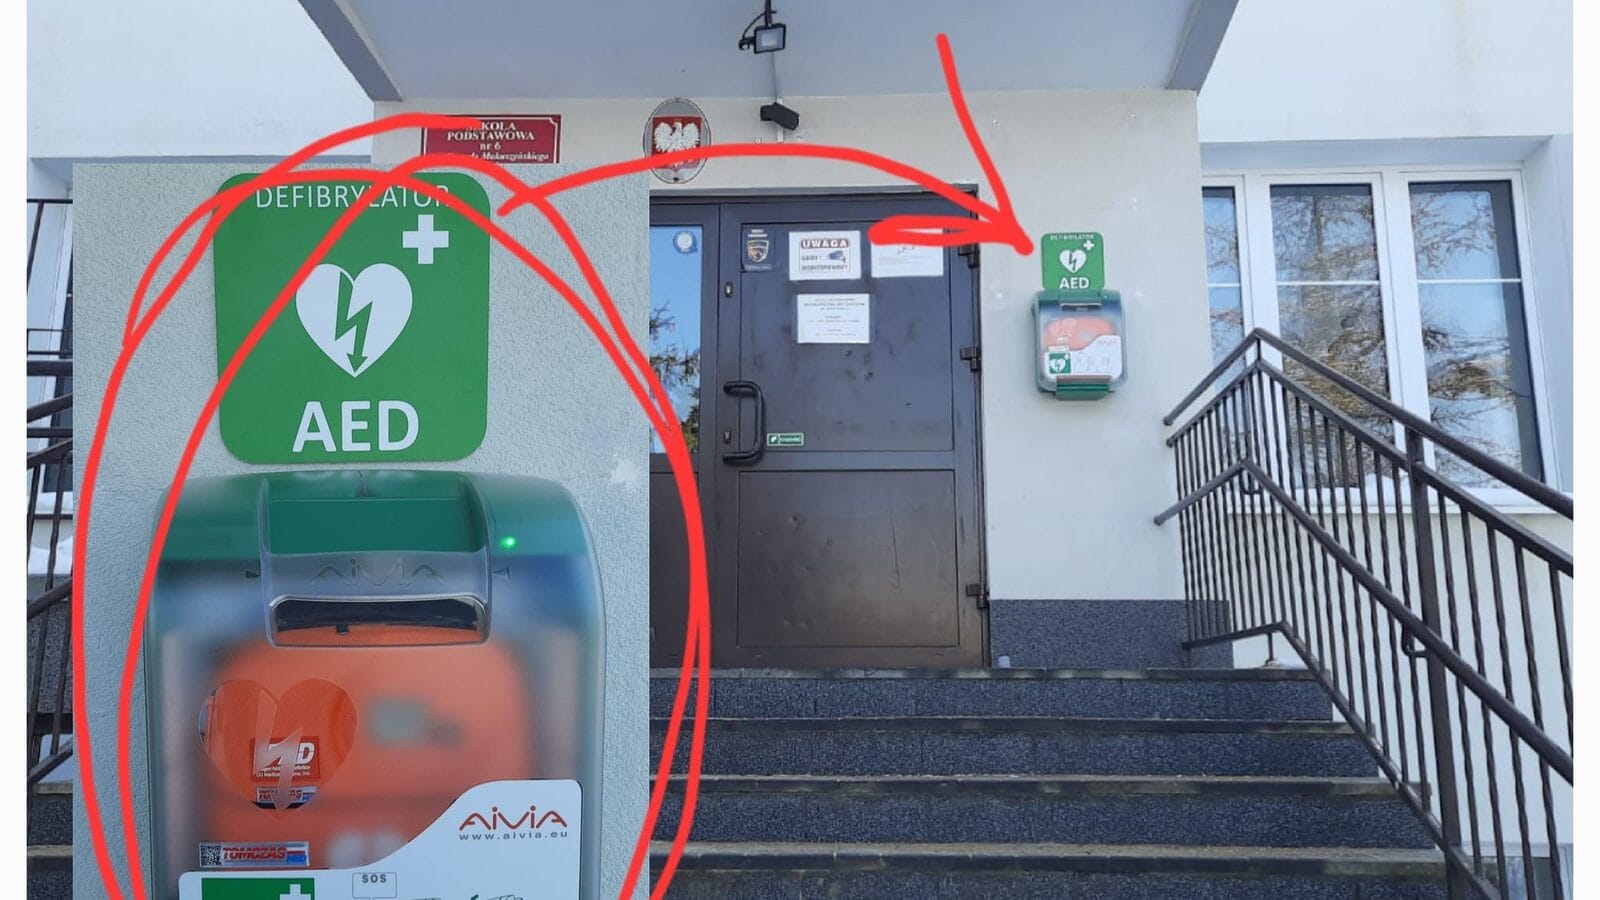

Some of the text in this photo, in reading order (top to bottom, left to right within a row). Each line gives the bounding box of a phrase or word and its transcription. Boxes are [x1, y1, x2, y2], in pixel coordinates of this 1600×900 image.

[447, 131, 535, 141] PODSTAWOWA
[480, 142, 502, 150] nr 6
[802, 239, 848, 248] UWAGA
[1059, 277, 1090, 289] AED
[292, 400, 419, 452] AED
[459, 830, 568, 841] www.aivia.eu
[223, 847, 287, 859] TOMCZAS
[361, 873, 388, 884] SOS
